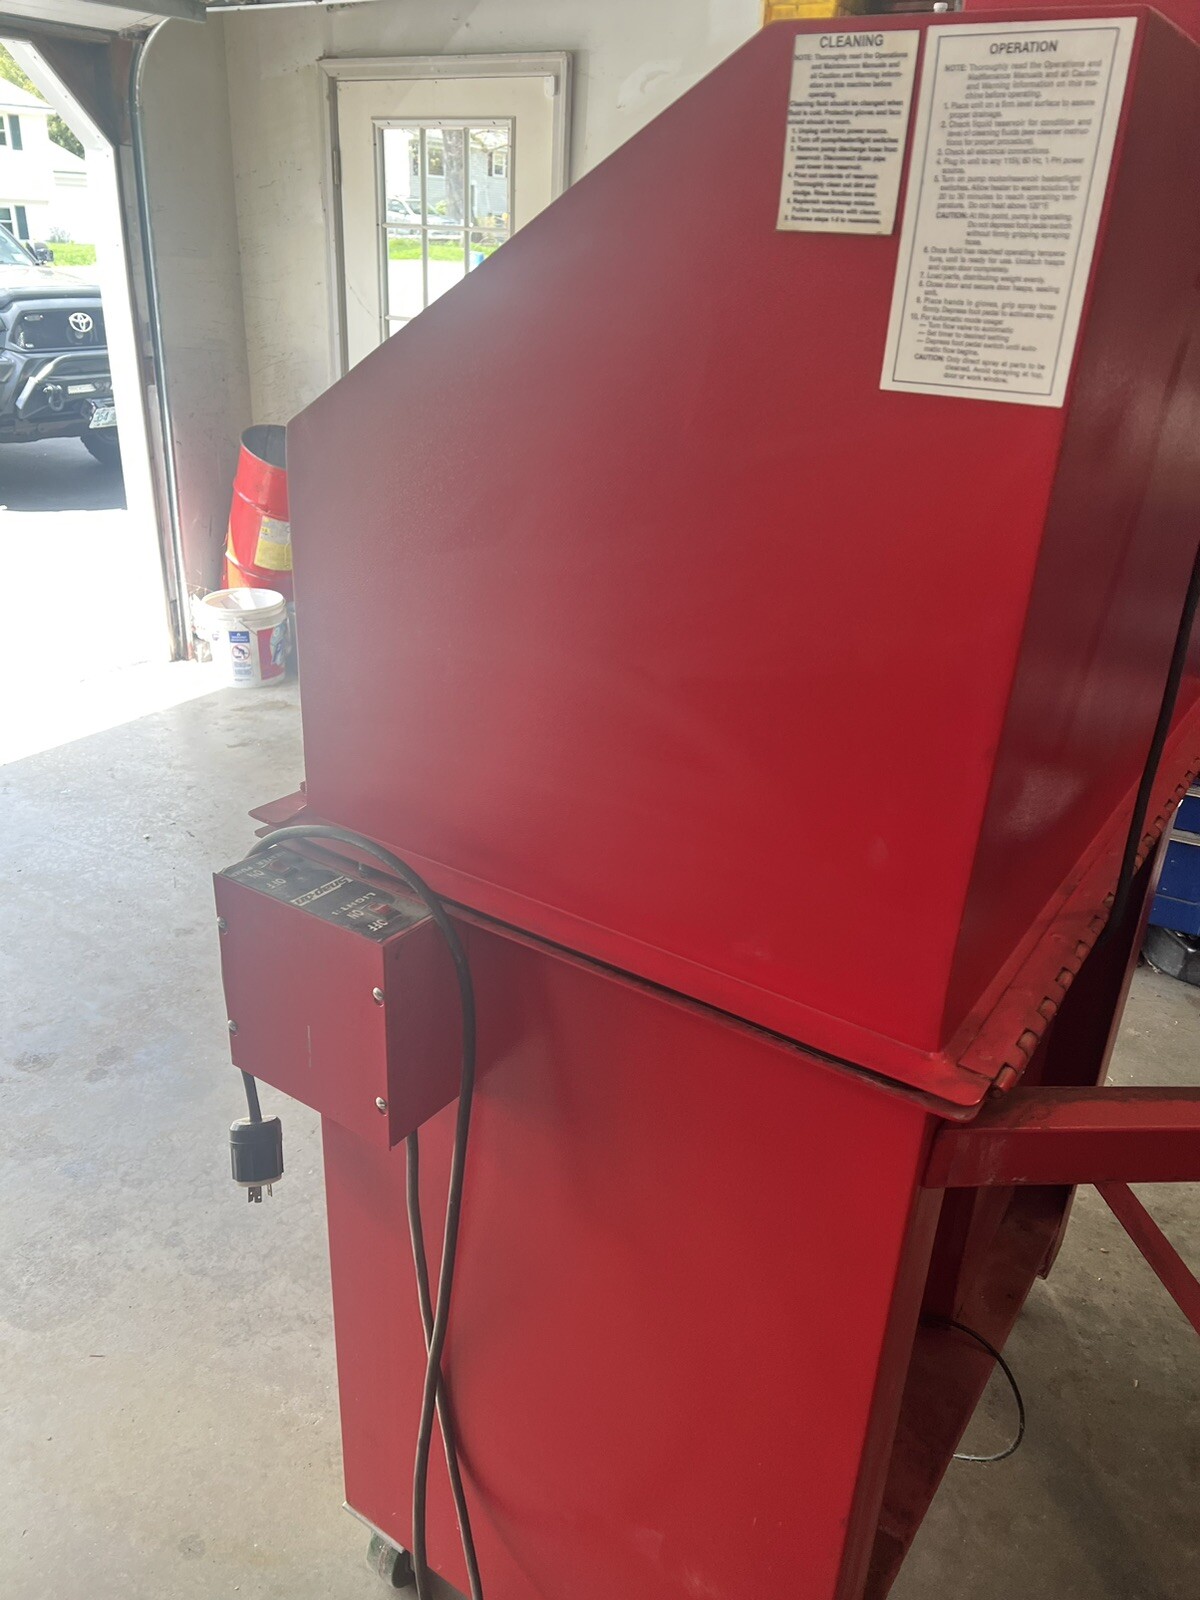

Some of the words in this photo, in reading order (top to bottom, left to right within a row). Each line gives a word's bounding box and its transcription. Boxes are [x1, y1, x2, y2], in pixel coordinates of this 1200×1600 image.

[819, 34, 884, 48] CLEANING
[989, 40, 1058, 54] OPERATION
[914, 353, 945, 362] CAUTION:
[266, 878, 287, 889] OFF
[346, 908, 365, 920] ON
[367, 919, 389, 932] OFF
